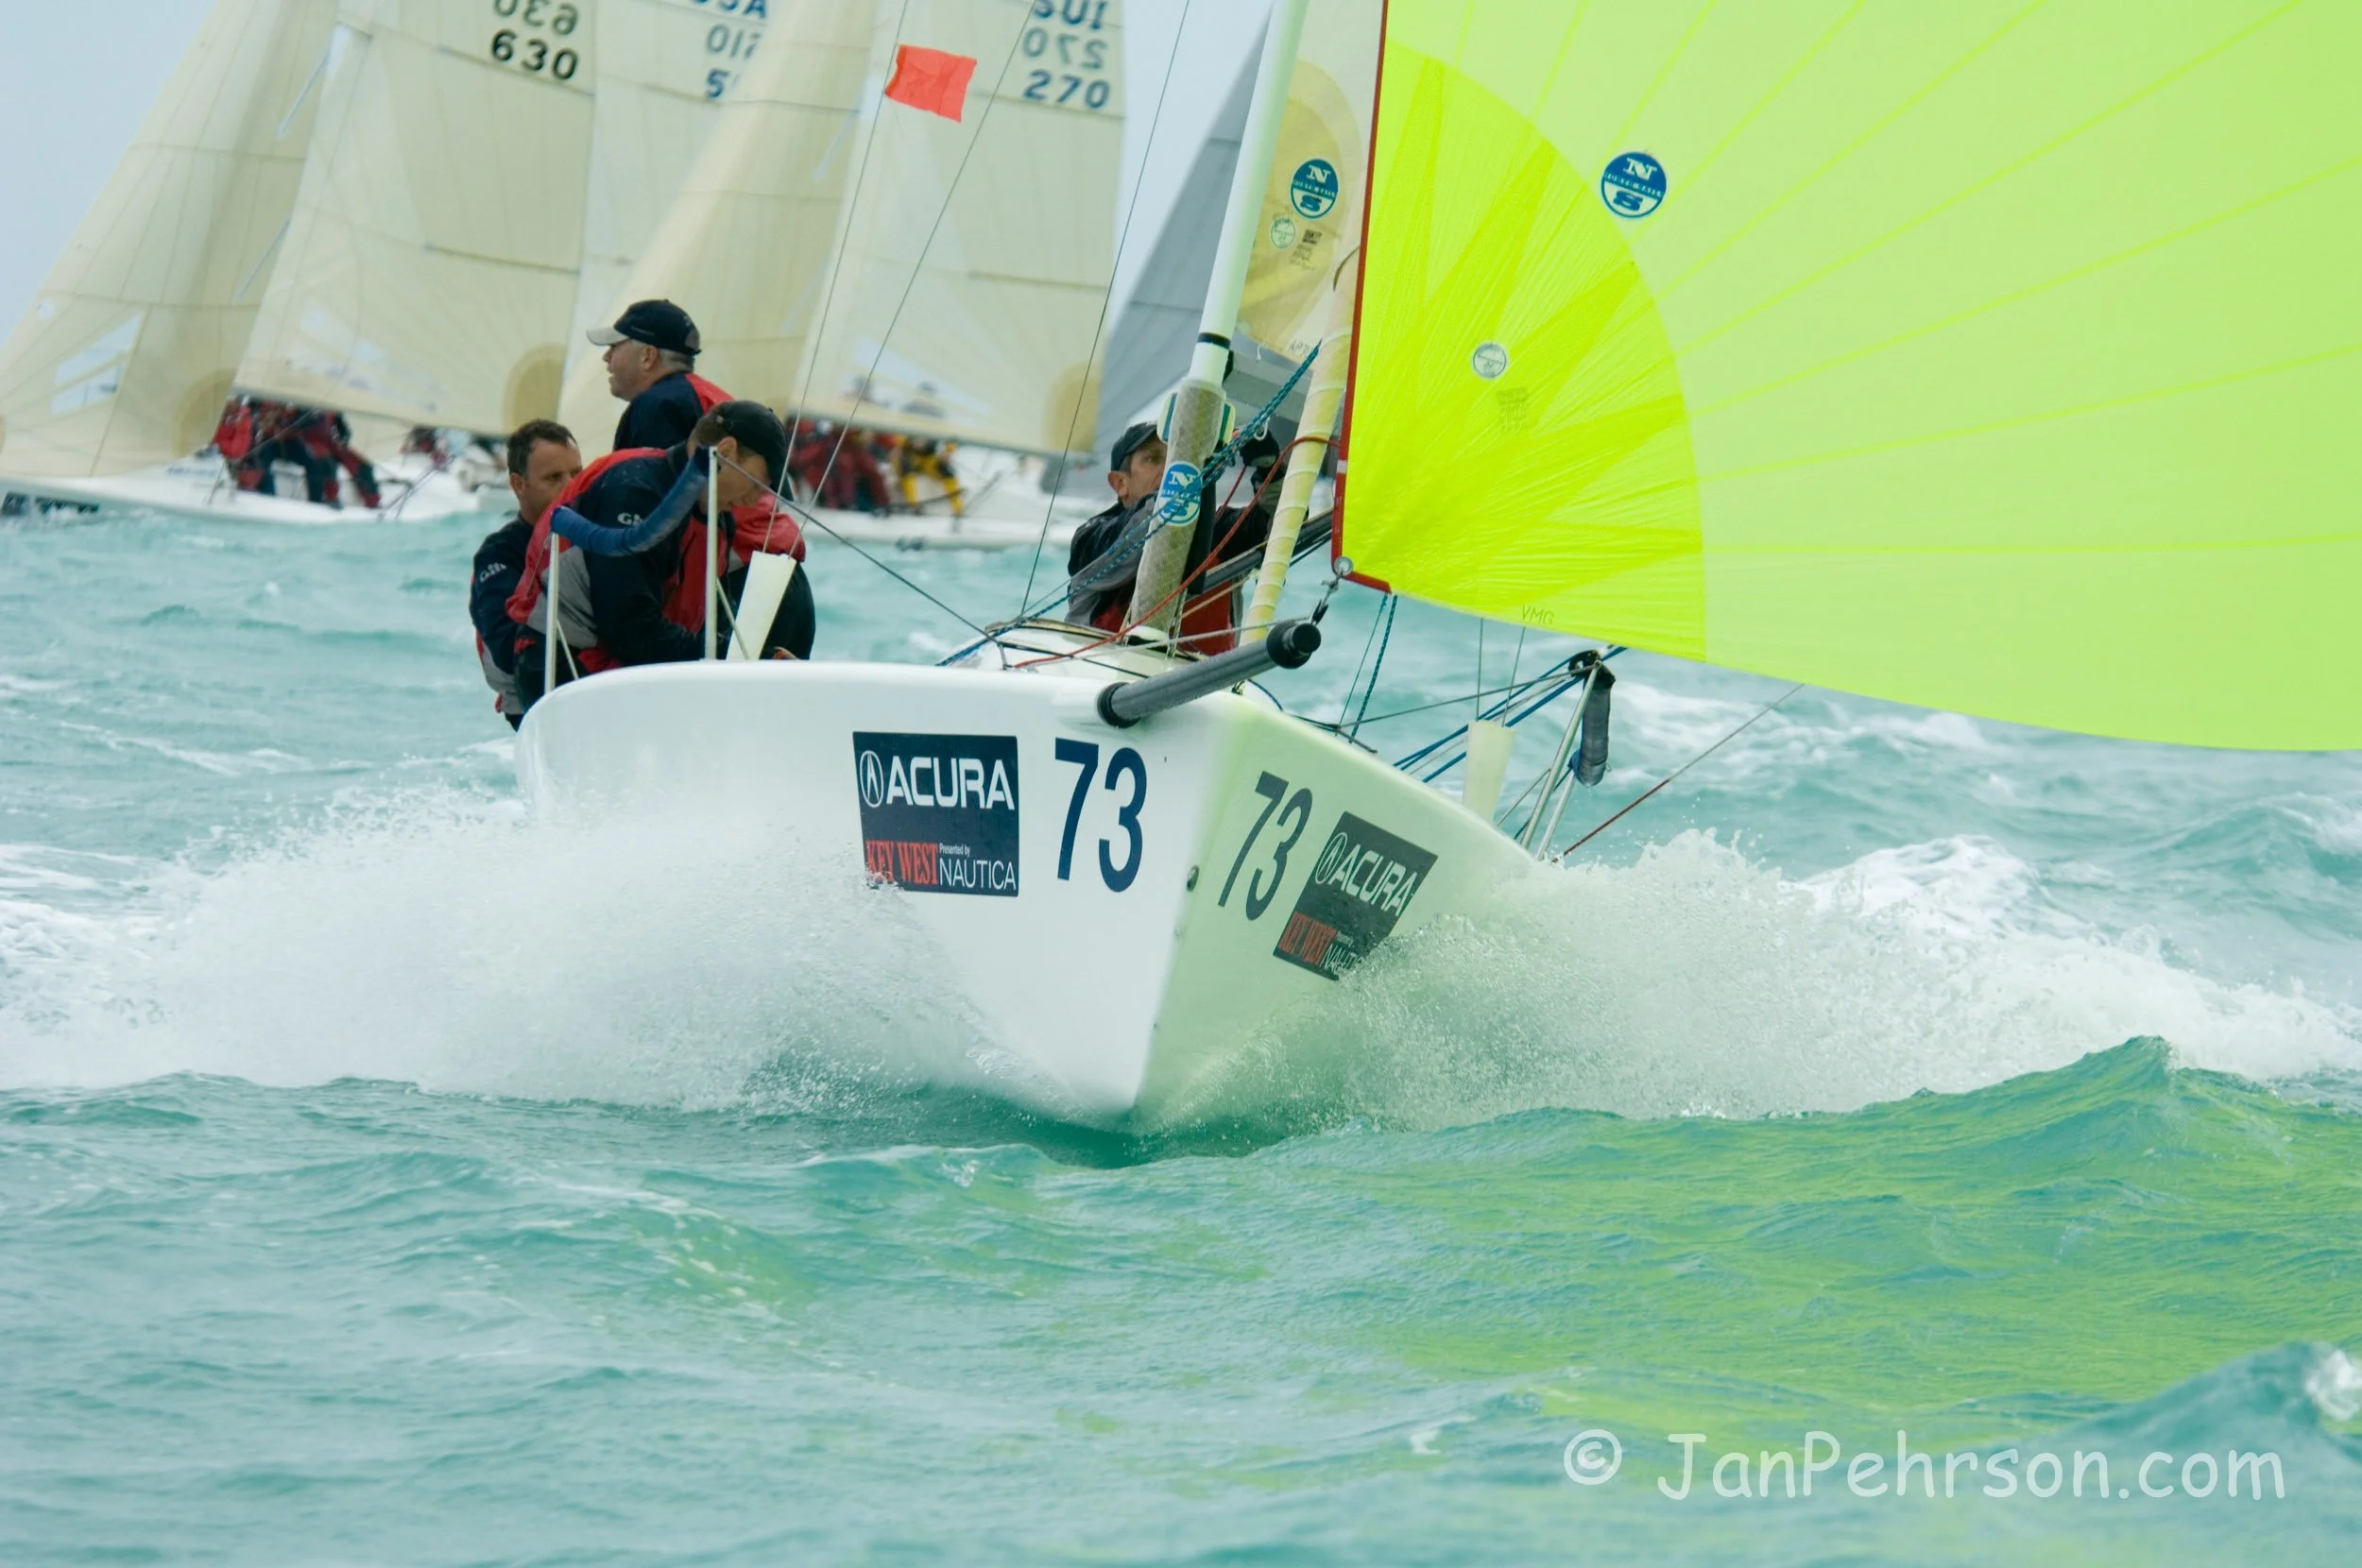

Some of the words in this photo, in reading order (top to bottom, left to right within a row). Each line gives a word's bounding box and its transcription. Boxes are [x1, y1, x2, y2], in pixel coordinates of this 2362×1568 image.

[491, 28, 579, 81] 630
[1023, 69, 1111, 109] 270
[1622, 157, 1658, 181] N
[886, 756, 1016, 810] ACURA
[1054, 737, 1148, 893] 73
[898, 842, 939, 885] WEST
[1218, 770, 1313, 921] 73
[939, 858, 1018, 891] NAUTICA
[1327, 844, 1418, 916] ACURA
